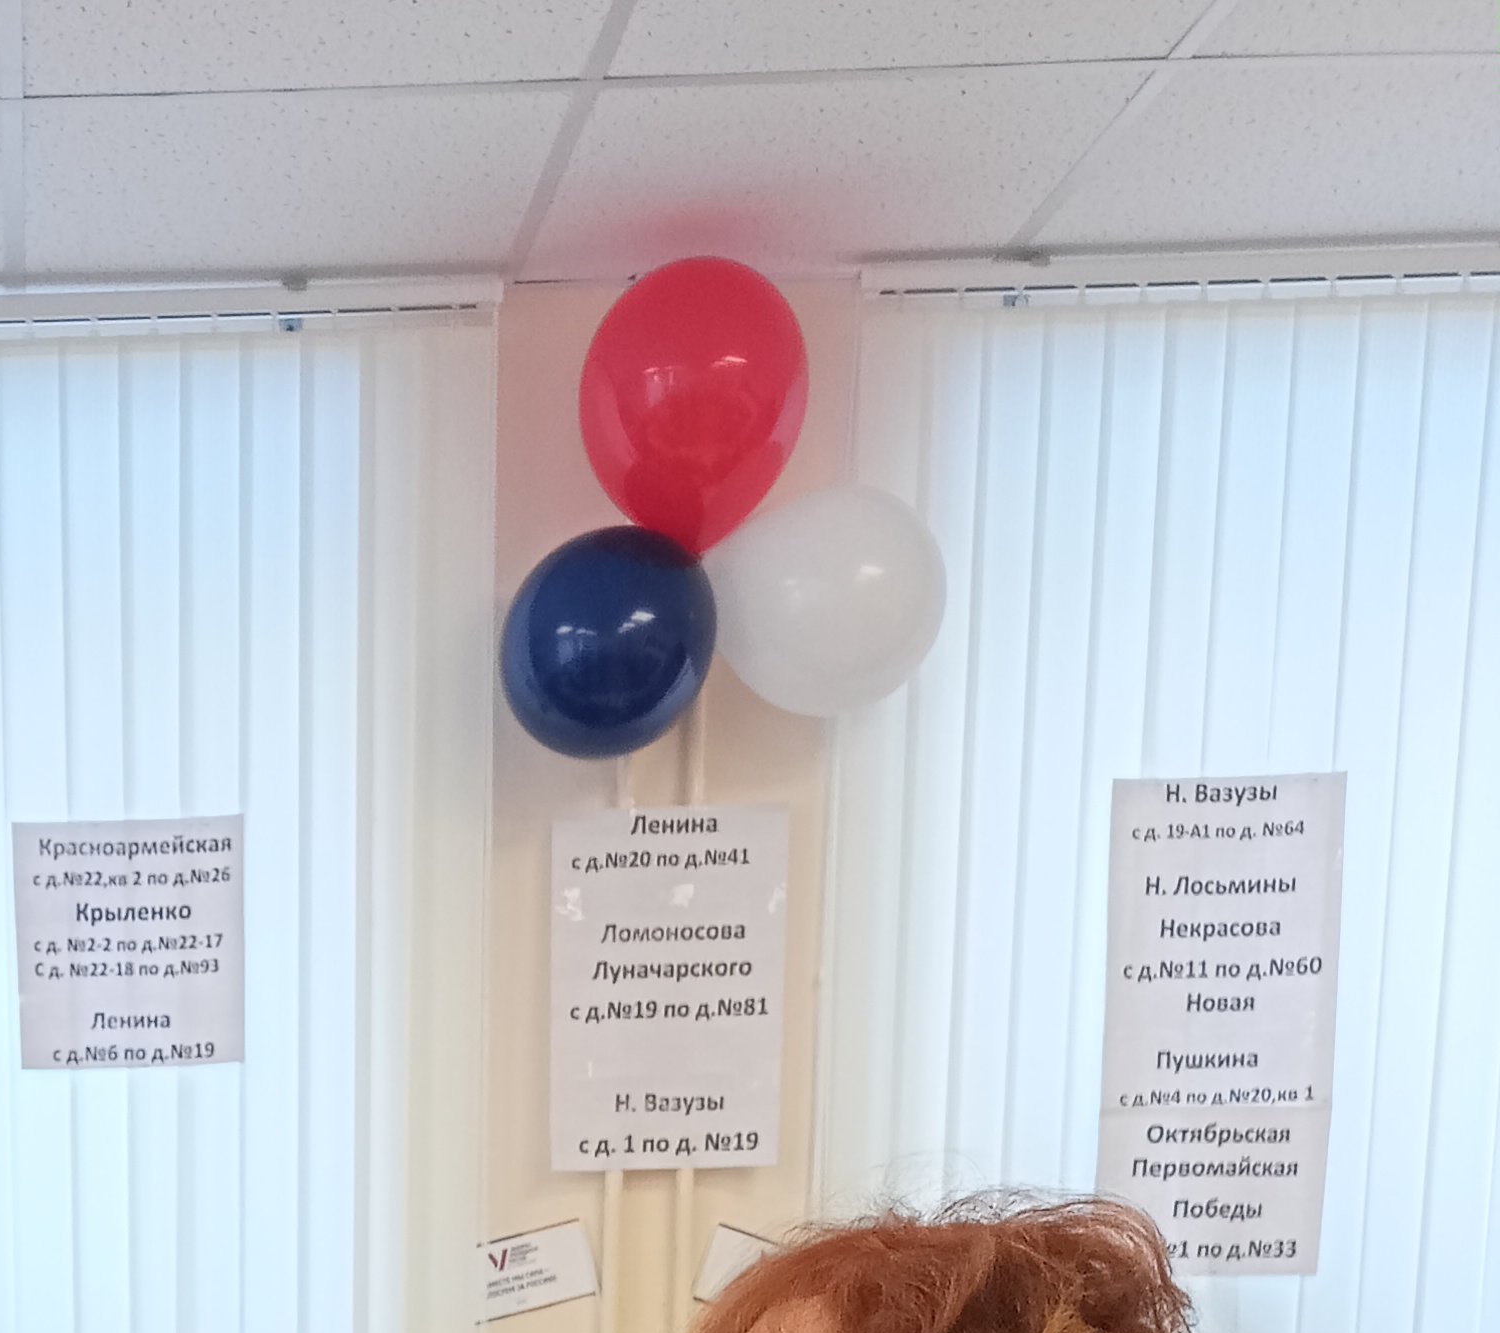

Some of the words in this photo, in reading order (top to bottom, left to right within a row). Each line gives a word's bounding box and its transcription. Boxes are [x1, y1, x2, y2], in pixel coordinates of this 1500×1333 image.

[1165, 783, 1187, 803] Н.
[1195, 784, 1278, 807] Вазузы
[631, 815, 719, 835] Ленина
[1132, 829, 1140, 840] с
[1215, 826, 1236, 839] по
[1262, 820, 1305, 838] №64
[39, 834, 232, 860] Красноармейская
[572, 856, 582, 870] с
[585, 850, 651, 874] д.№20
[656, 853, 680, 867] по
[684, 848, 750, 870] д.№41
[33, 874, 41, 886] с
[133, 871, 141, 885] 2
[147, 873, 168, 885] по
[173, 867, 231, 887] д.№26
[1145, 875, 1167, 896] Н.
[1173, 876, 1297, 895] Лосьмины
[76, 903, 191, 926] Крыленко
[600, 923, 746, 944] Ломоносова
[1160, 918, 1281, 942] Некрасова
[34, 940, 41, 952] с
[117, 939, 136, 952] по
[142, 933, 223, 954] д.№22-17
[139, 963, 158, 975] по
[163, 959, 219, 978] д.№93
[592, 960, 753, 984] Луначарского
[1123, 965, 1133, 979] с
[1137, 960, 1208, 983] д.№11
[1215, 963, 1240, 977] по
[1246, 956, 1322, 981] д.№60
[570, 1005, 580, 1021] с
[585, 1001, 657, 1025] д.№19
[664, 1003, 690, 1019] по
[695, 997, 769, 1021] д.№81
[1186, 993, 1255, 1012] Новая
[91, 1012, 171, 1030] Ленина
[53, 1049, 61, 1062] с
[66, 1045, 118, 1064] д.№6
[124, 1047, 145, 1060] по
[151, 1042, 215, 1063] д.№19
[1156, 1050, 1259, 1075] Пушкина
[615, 1093, 637, 1113] Н.
[644, 1094, 724, 1116] Вазузы
[1119, 1095, 1128, 1107] с
[1186, 1093, 1207, 1105] по
[1305, 1085, 1314, 1100] 1
[579, 1138, 589, 1154] с
[594, 1138, 616, 1158] д.
[623, 1135, 635, 1153] 1
[642, 1136, 670, 1153] по
[675, 1135, 697, 1157] д.
[704, 1131, 759, 1153] №19
[1146, 1121, 1290, 1147] Октябрьская
[1132, 1156, 1298, 1181] Первомайская
[1173, 1197, 1262, 1222] Победы
[1196, 1243, 1221, 1258] по
[1226, 1240, 1297, 1261] д.№33
